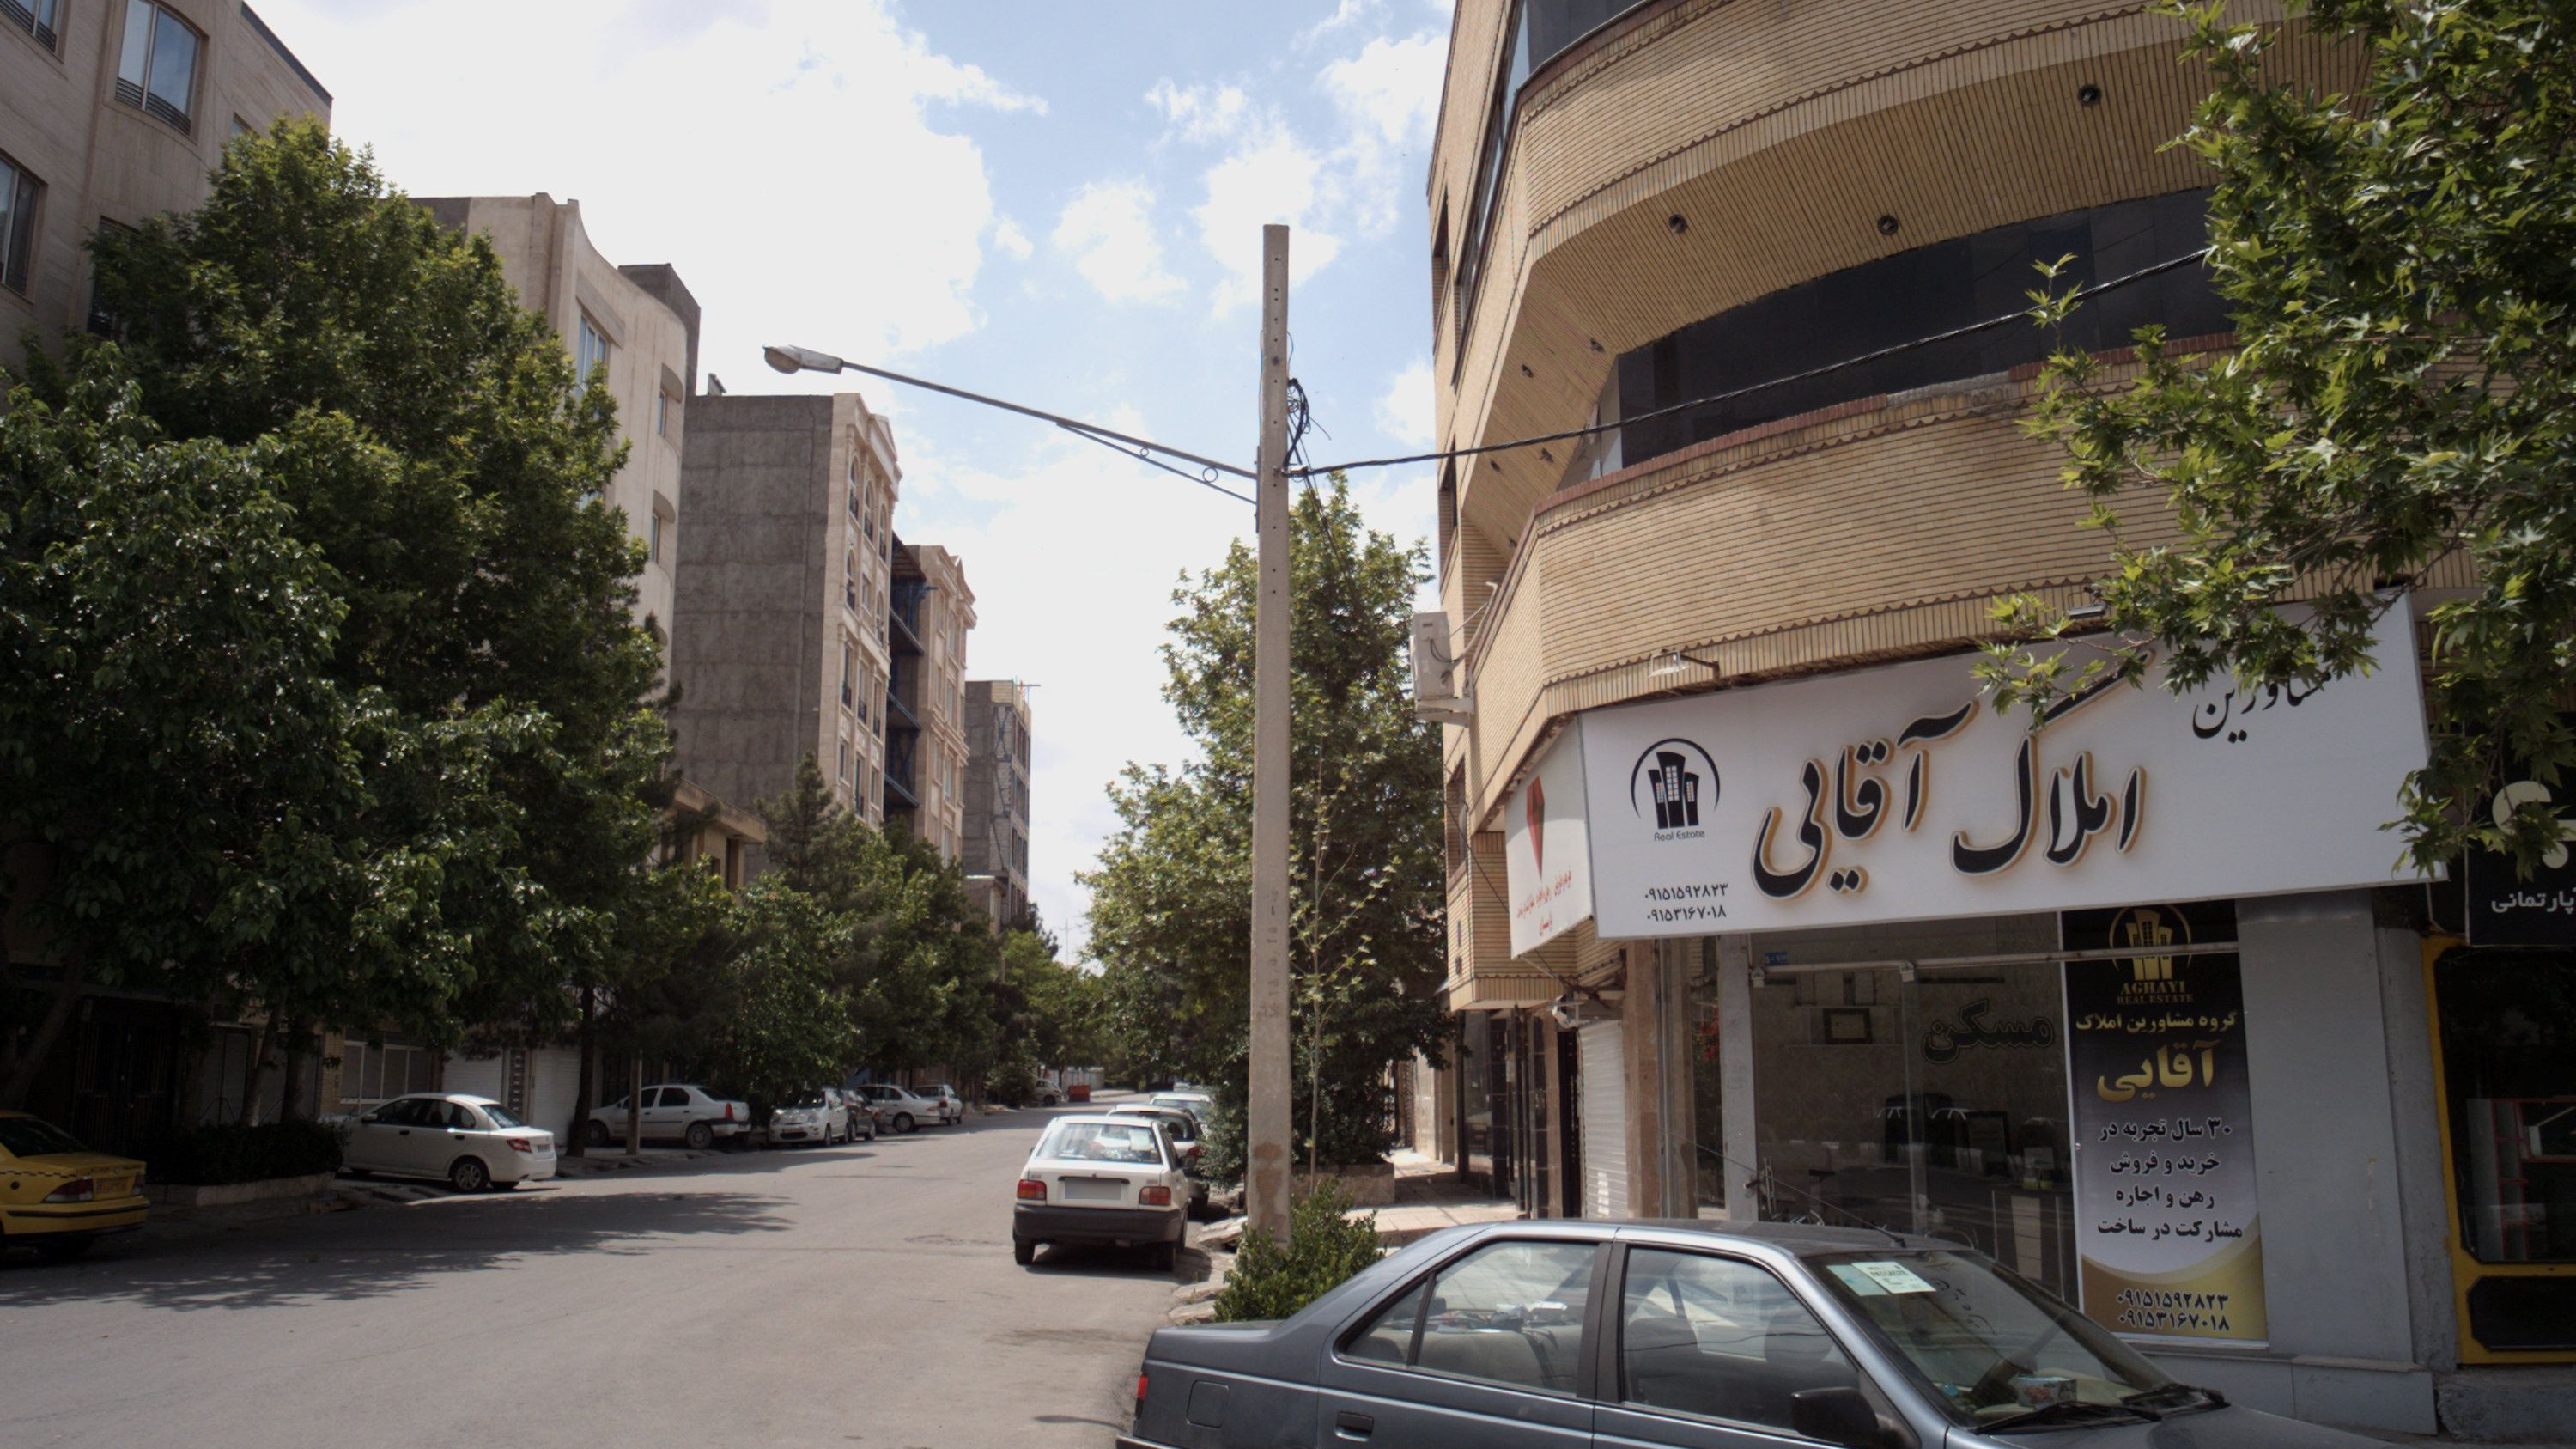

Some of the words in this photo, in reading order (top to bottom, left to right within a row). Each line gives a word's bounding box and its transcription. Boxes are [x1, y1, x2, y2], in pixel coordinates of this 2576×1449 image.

[1950, 648, 2156, 877] املاک
[1751, 700, 1979, 902] آقایی
[1654, 831, 1674, 842] Real
[1676, 830, 1705, 840] Estate
[1644, 883, 1728, 901] ۰۹۱۵۱۵۹۲۸۲۳
[2490, 886, 2576, 915] پارتمانی
[1647, 904, 1727, 922] ۰۹۱۵۳۱۶۷۰۱۸
[2120, 980, 2186, 995] AGHAYI
[2117, 995, 2148, 1005] REAL
[2148, 994, 2196, 1004] ESTATE
[1921, 997, 2056, 1065] مسکن
[2075, 1012, 2122, 1031] املاک
[2126, 1011, 2194, 1033] مشاورین
[2198, 1009, 2238, 1032] گروه
[2097, 1039, 2221, 1103] آقایی
[2098, 1122, 2118, 1142] در
[2122, 1120, 2166, 1143] تجربه
[2171, 1120, 2202, 1142] سال
[2208, 1117, 2232, 1138] ۳۰
[2110, 1151, 2159, 1176] فروش
[2164, 1162, 2172, 1177] و
[2177, 1153, 2220, 1175] خرید
[2115, 1186, 2160, 1208] اجاره
[2166, 1194, 2174, 1208] و
[2178, 1192, 2215, 1209] رهن
[2098, 1217, 2146, 1235] ساخت
[2151, 1222, 2171, 1240] در
[2174, 1220, 2244, 1243] مشارکت
[2117, 1288, 2229, 1311] ۰۹۱۵۱۵۹۲۸۲۳
[2118, 1310, 2230, 1331] ۰۹۱۵۳۱۶۷۰۱۸
